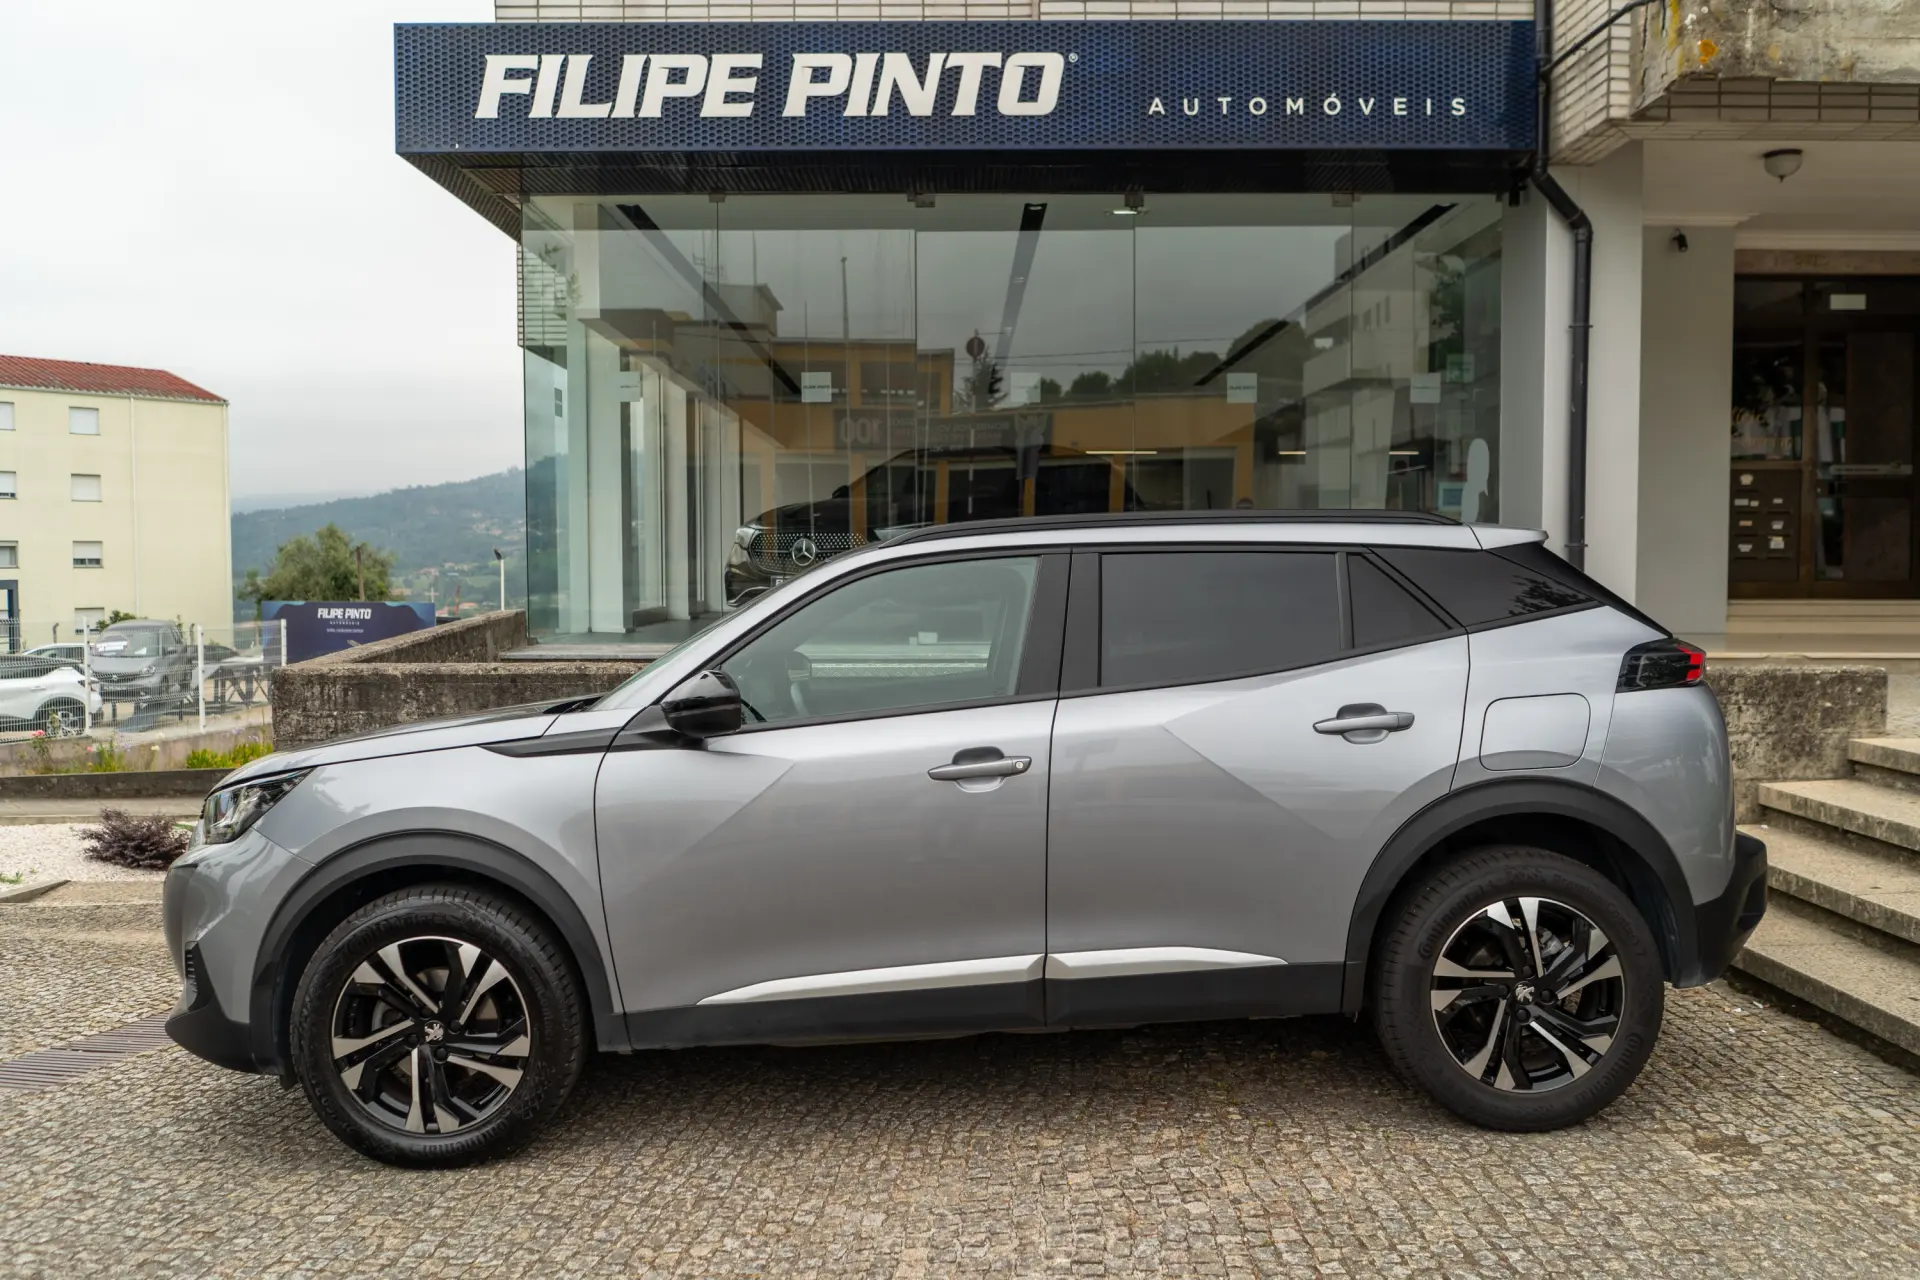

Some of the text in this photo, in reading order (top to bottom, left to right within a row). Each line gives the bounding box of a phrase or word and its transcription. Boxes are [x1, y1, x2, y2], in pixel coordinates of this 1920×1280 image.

[475, 53, 1064, 118] FILIPE PINTO
[1149, 93, 1465, 115] AUTOMÓVEIS
[317, 607, 372, 620] FILIPE PINTO
